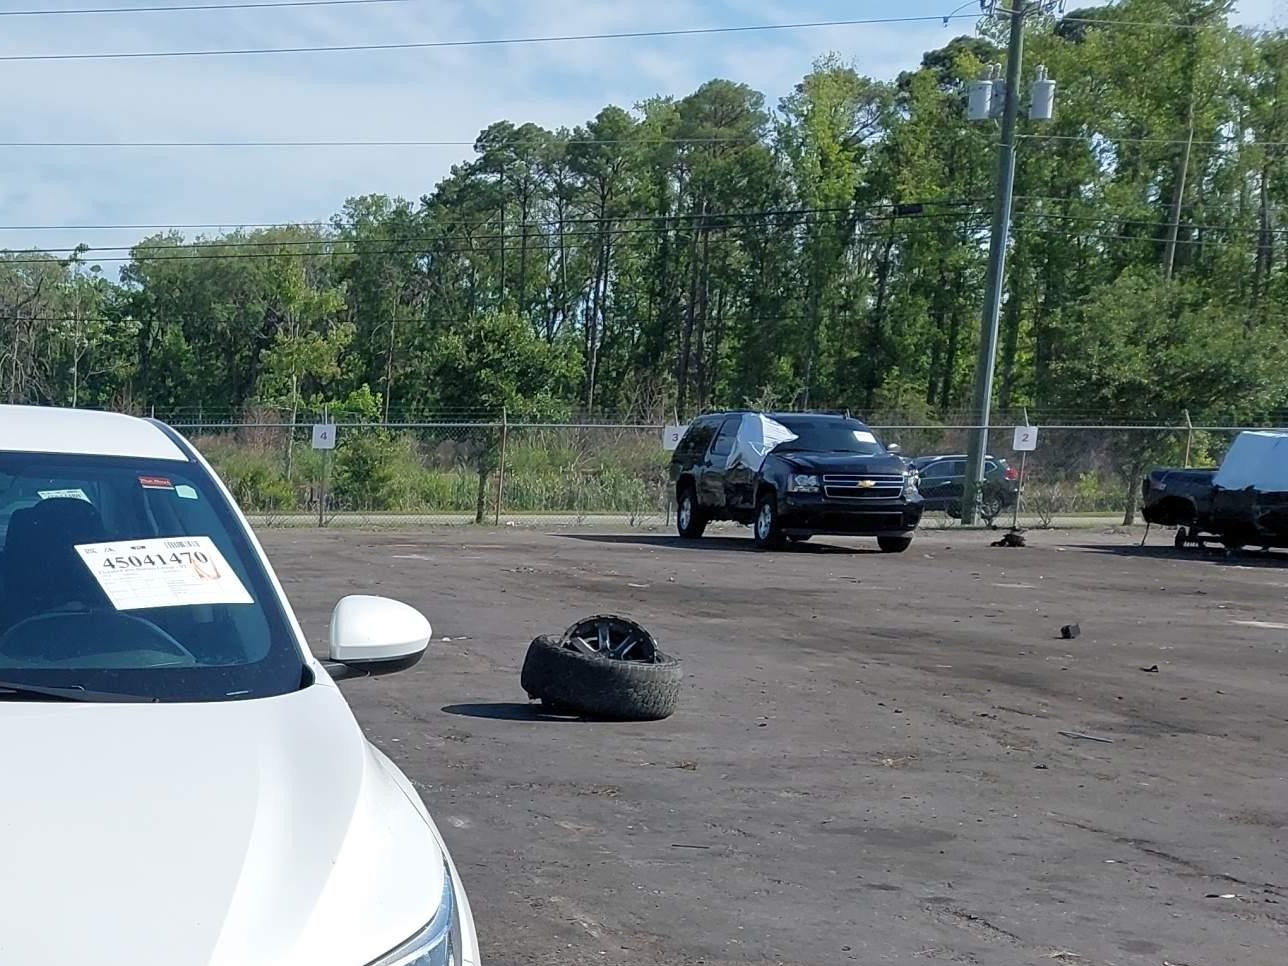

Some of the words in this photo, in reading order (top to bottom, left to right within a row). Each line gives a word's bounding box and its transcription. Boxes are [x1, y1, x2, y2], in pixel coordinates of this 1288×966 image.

[320, 431, 328, 441] 4
[672, 433, 679, 442] 3
[1021, 433, 1030, 442] 2
[102, 551, 209, 570] 45041470
